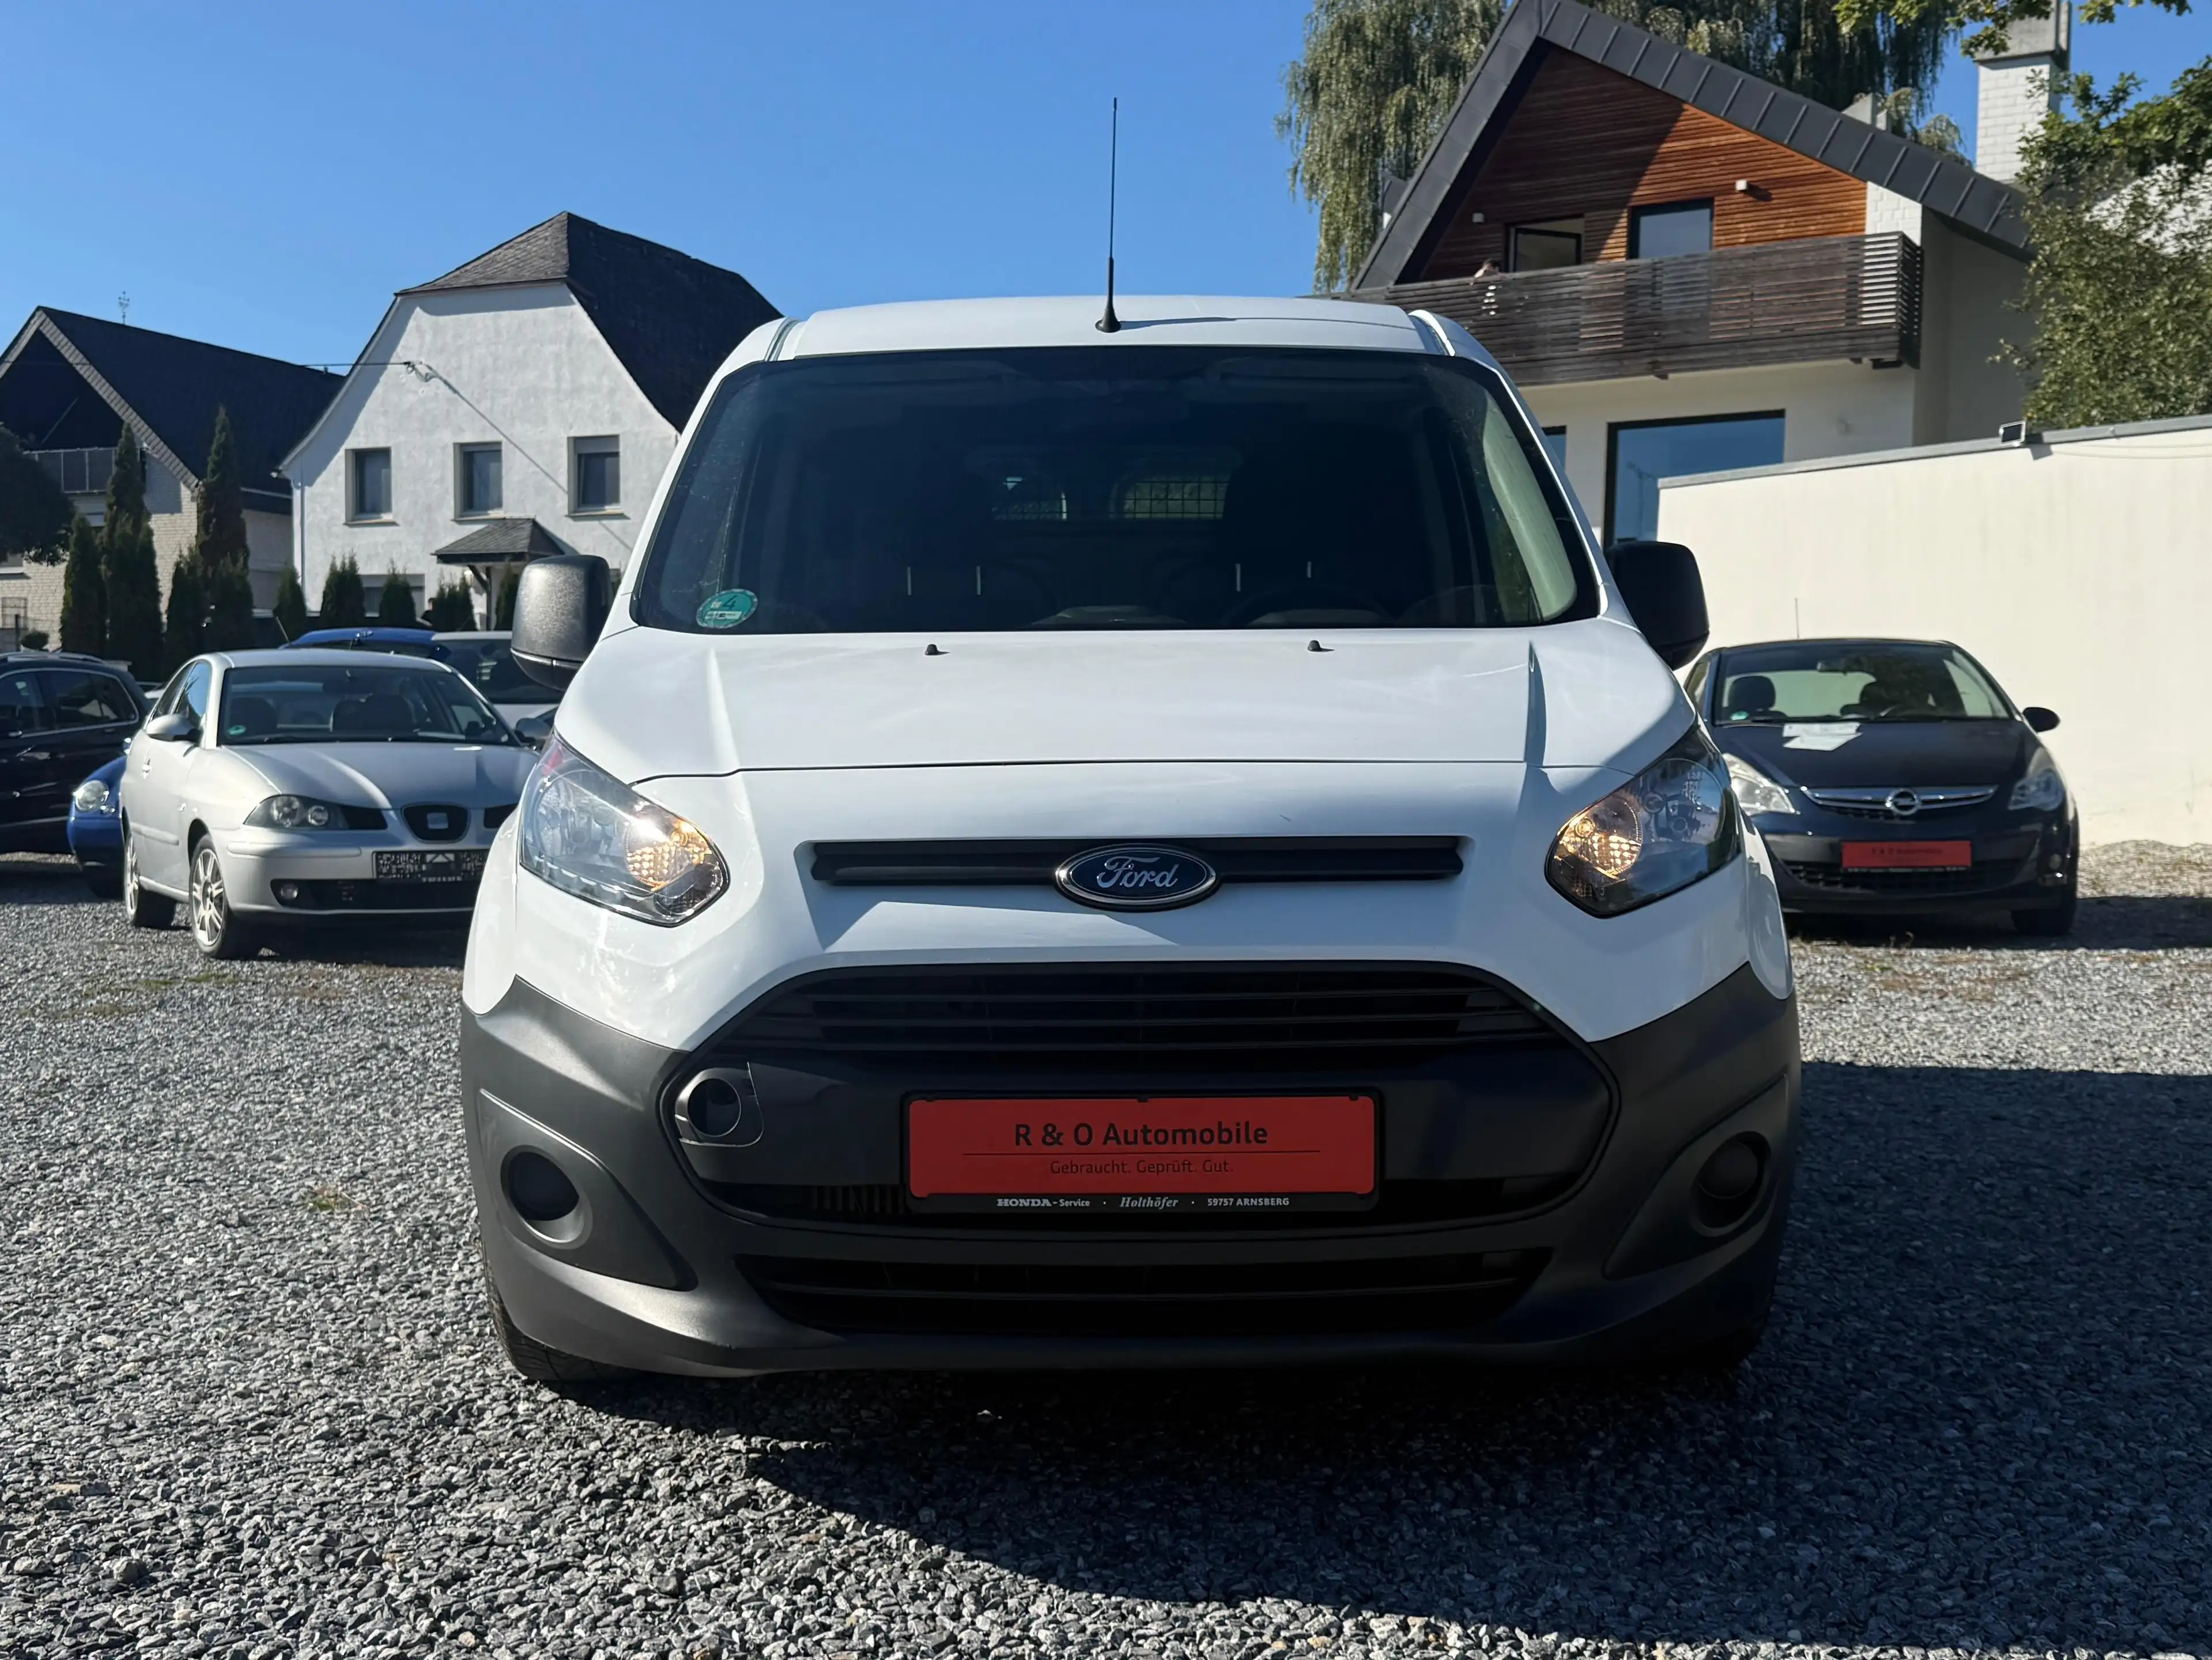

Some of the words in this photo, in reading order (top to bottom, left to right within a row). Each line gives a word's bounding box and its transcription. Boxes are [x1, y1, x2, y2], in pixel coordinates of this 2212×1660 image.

[722, 594, 738, 610] 4
[1096, 856, 1179, 888] Ford
[1015, 1123, 1033, 1146] R
[1041, 1123, 1064, 1146] &
[1074, 1123, 1093, 1146] O
[1103, 1120, 1268, 1146] Automobile
[1050, 1160, 1132, 1175] Gebraucht.
[1137, 1159, 1198, 1176] Geprüft.
[1202, 1159, 1235, 1173] Gut.
[1119, 1196, 1179, 1210] Holthöfer
[1207, 1197, 1234, 1206] 59757
[1236, 1197, 1290, 1206] ARNSBERG
